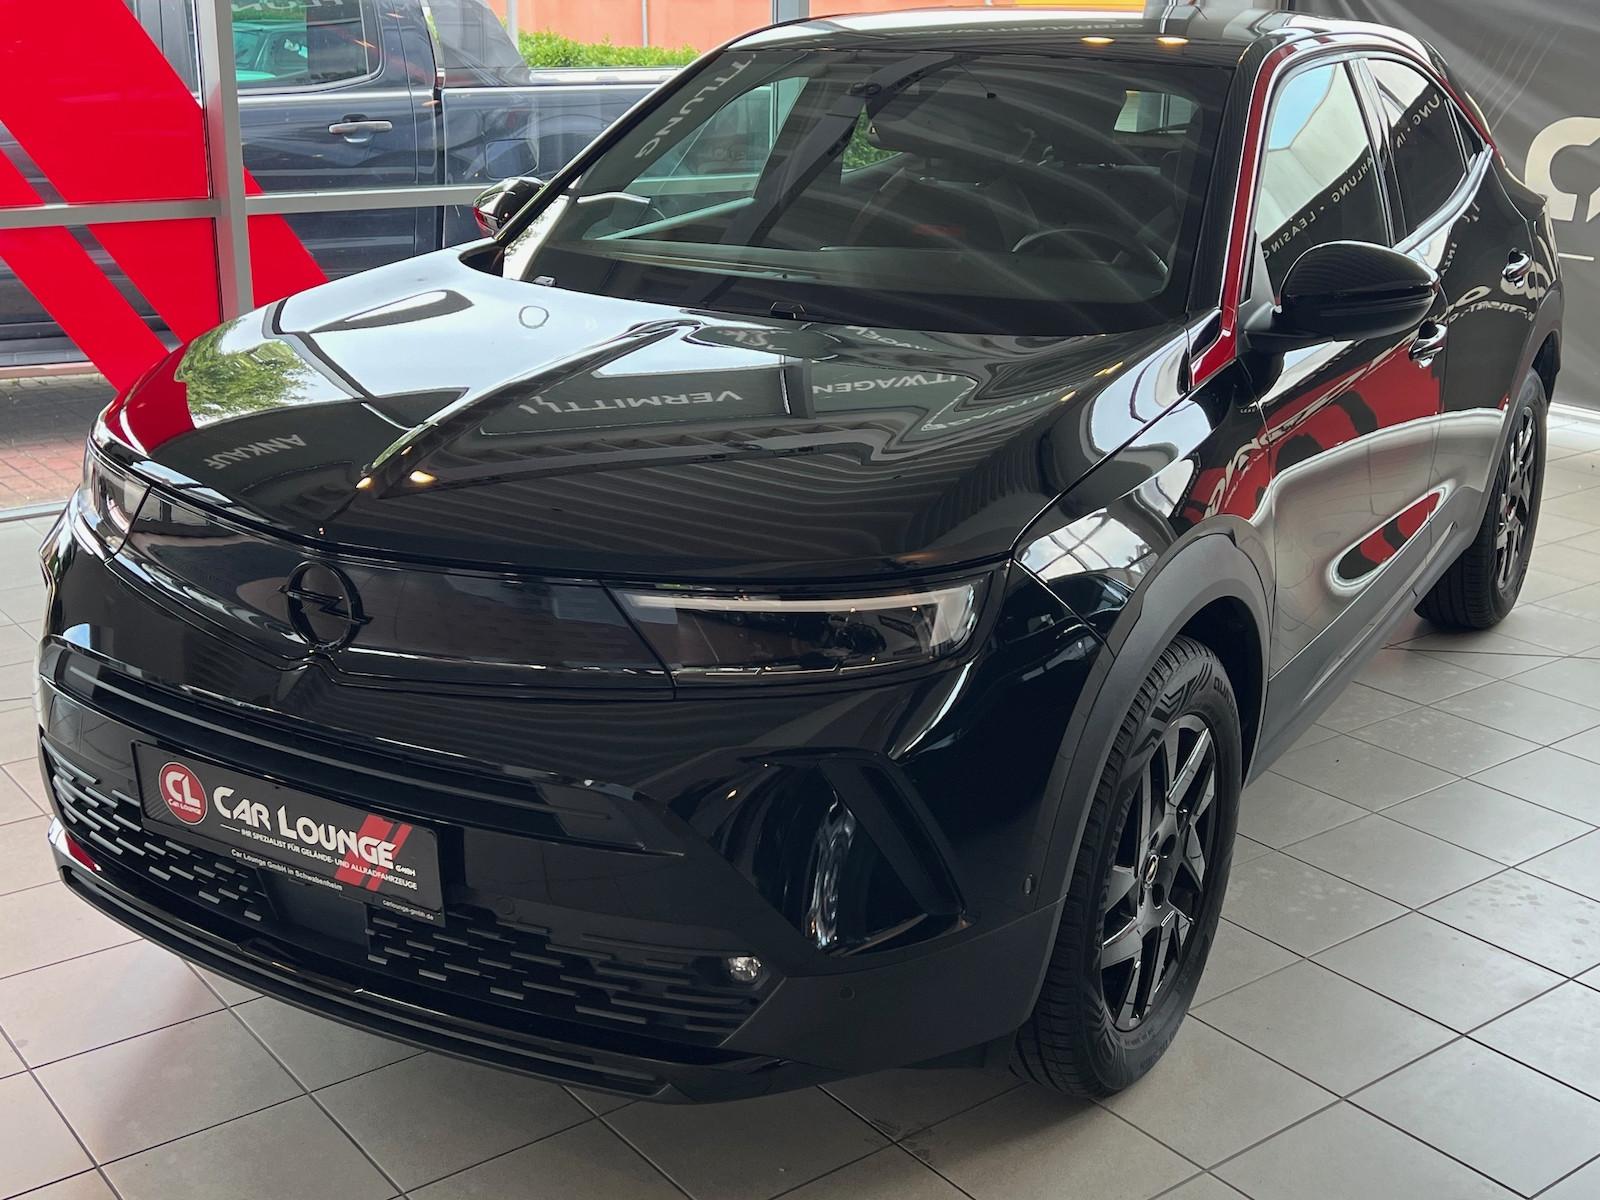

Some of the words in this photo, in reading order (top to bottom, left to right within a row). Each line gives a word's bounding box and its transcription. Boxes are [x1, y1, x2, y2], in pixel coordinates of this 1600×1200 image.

[634, 53, 756, 160] TTLUNG
[203, 434, 307, 470] ANKAUF
[165, 770, 202, 808] CL
[213, 786, 272, 832] CAR
[277, 805, 396, 870] LOUNGE
[231, 848, 243, 858] Car
[243, 852, 267, 867] Lounge
[266, 860, 287, 873] GmbH
[287, 866, 295, 875] in
[295, 870, 343, 891] Schwabenheim
[240, 828, 252, 838] IHR
[252, 831, 287, 849] SPEZIALIST
[287, 842, 301, 854] FÜR
[301, 847, 334, 863] GELÄNDE-
[334, 858, 350, 869] UND
[351, 864, 418, 890] ALLRADFAHRZEUGE
